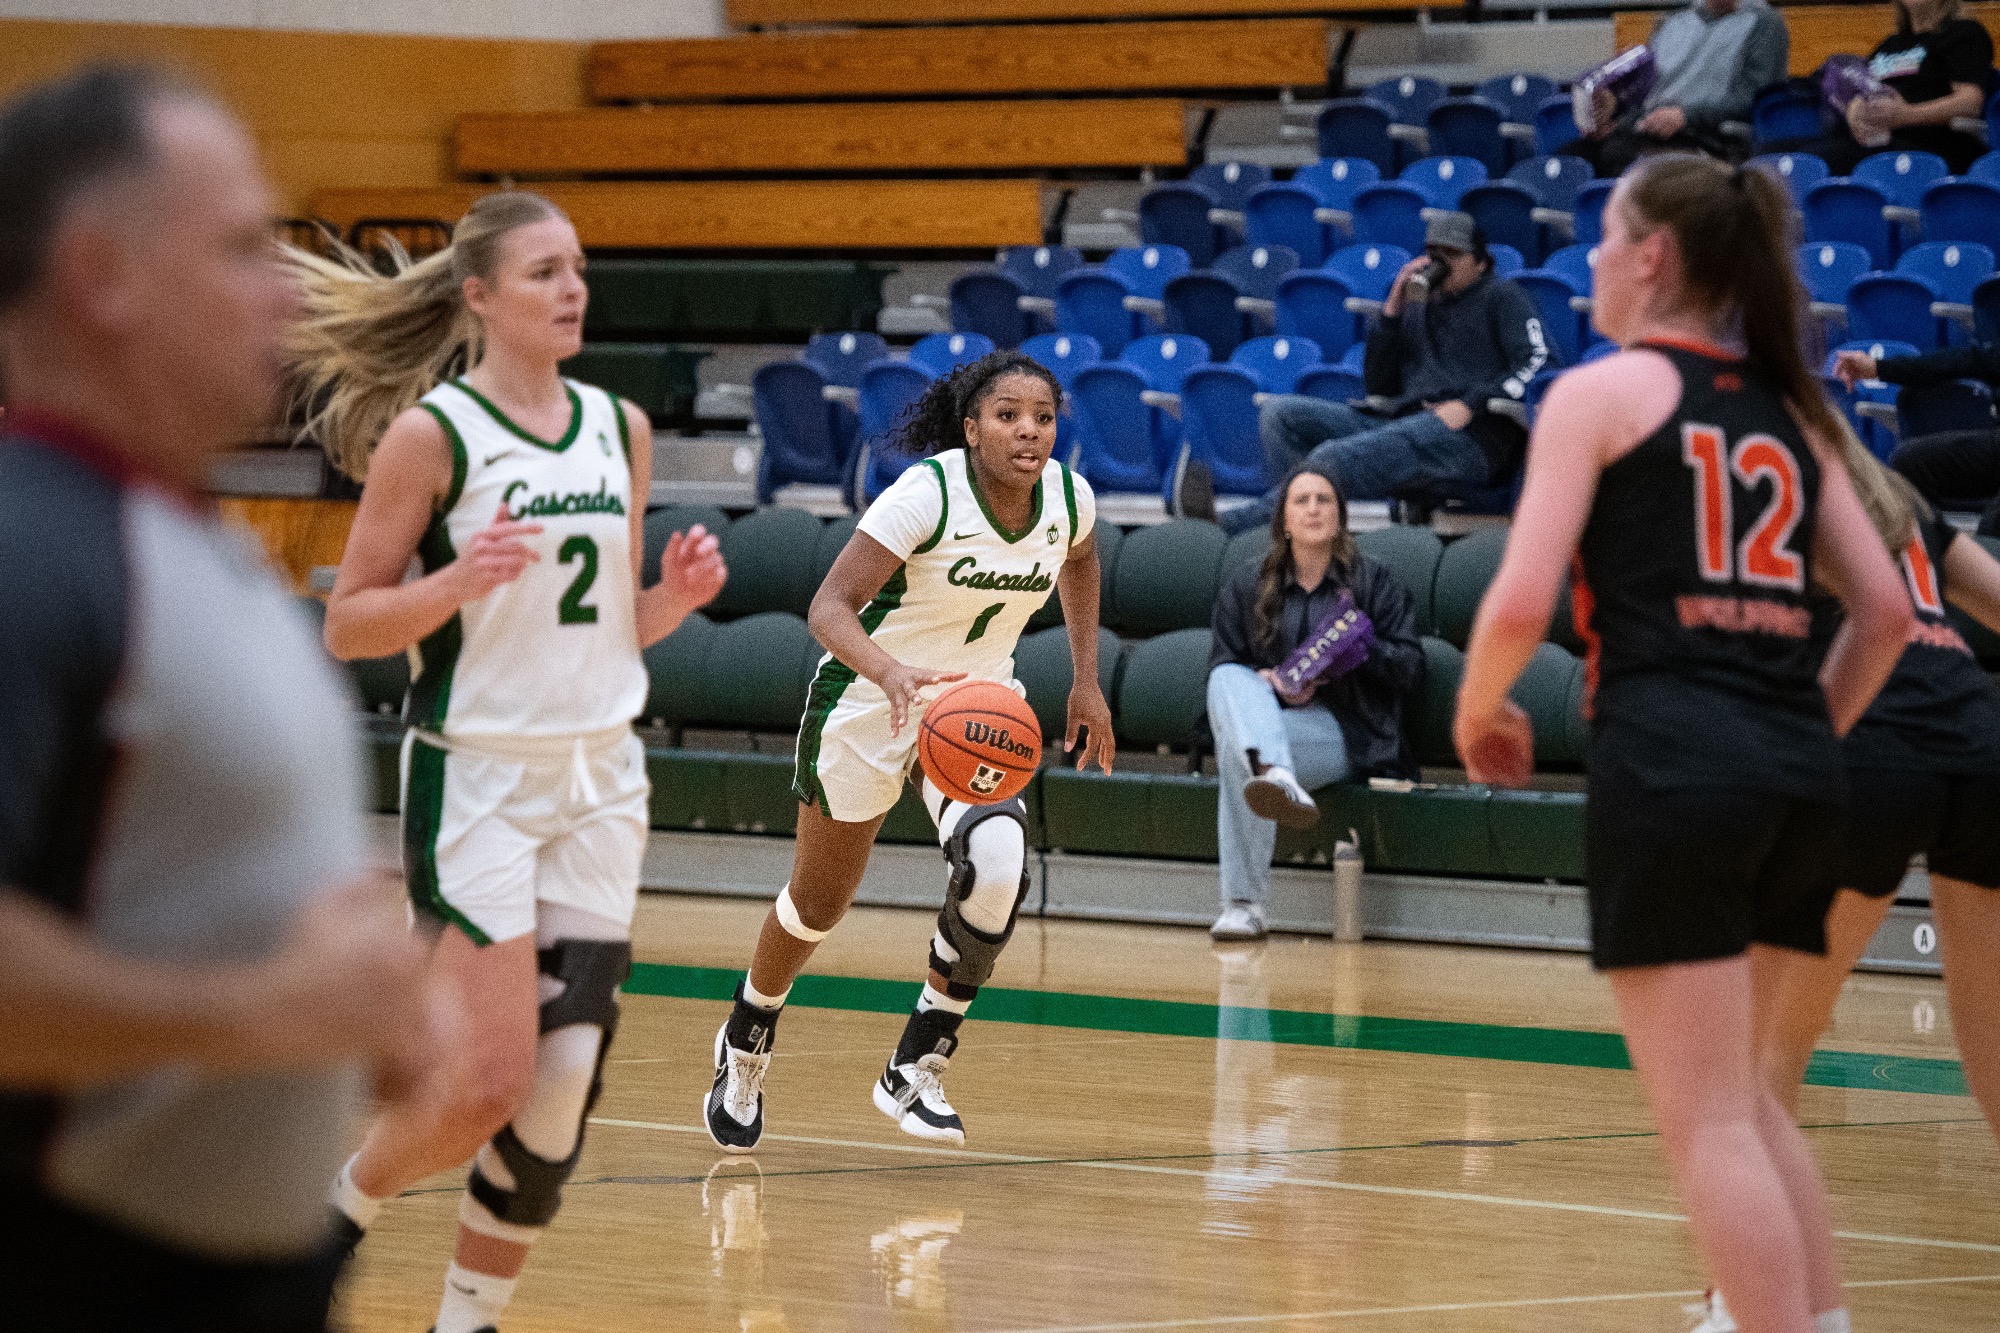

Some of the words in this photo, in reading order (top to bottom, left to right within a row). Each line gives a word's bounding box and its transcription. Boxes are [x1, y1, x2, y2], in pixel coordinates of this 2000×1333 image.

[1680, 422, 1805, 592] 12
[557, 534, 599, 625] 2
[947, 556, 1053, 592] Cascades
[964, 720, 1034, 761] Wilson
[1920, 928, 1929, 947] A
